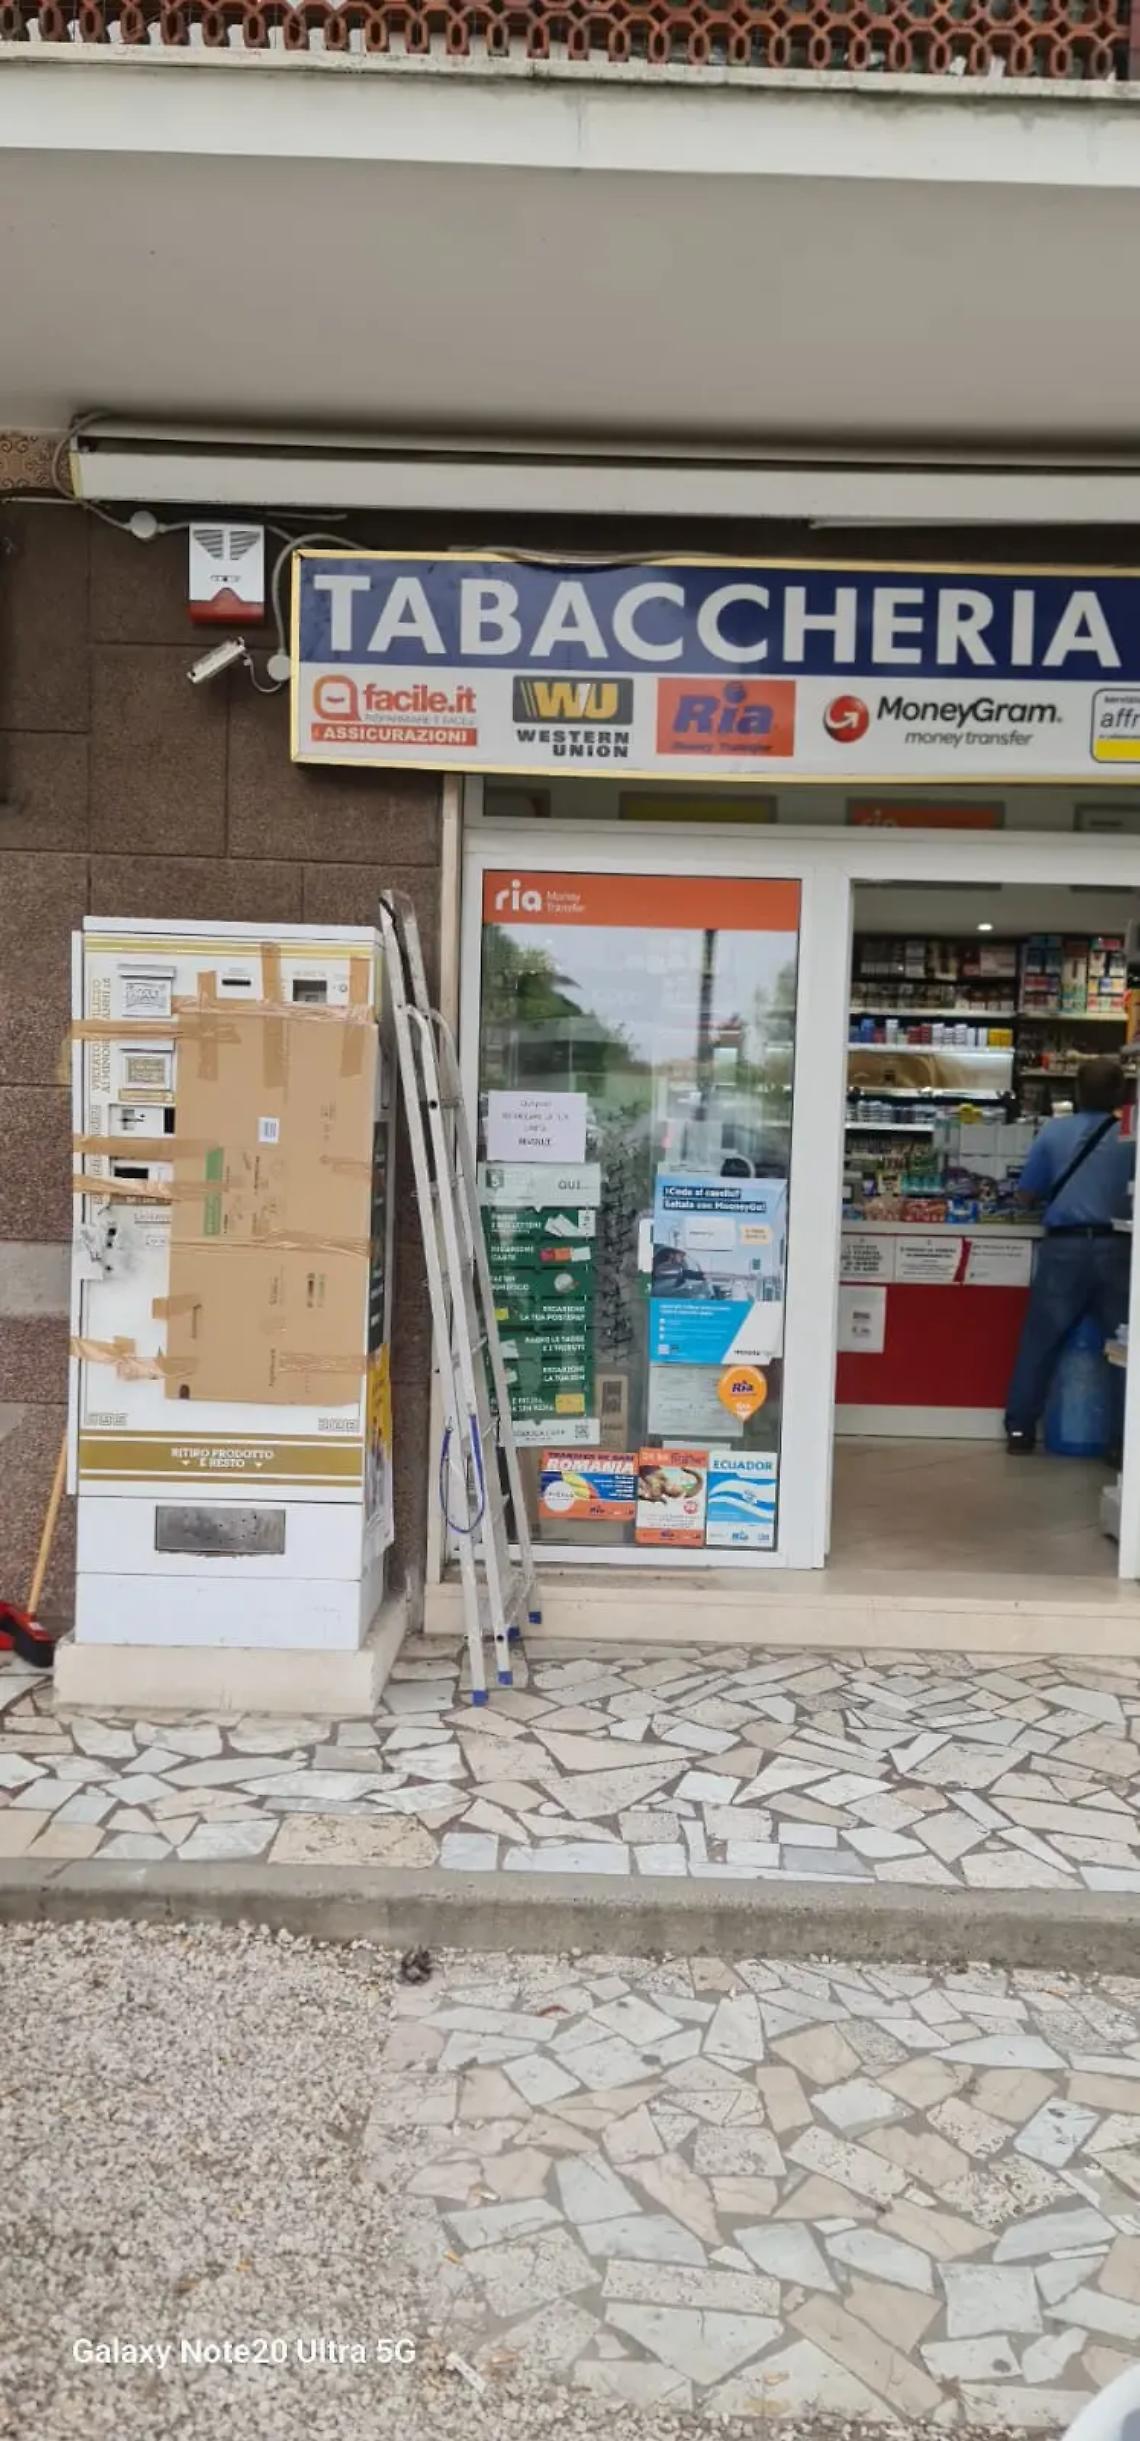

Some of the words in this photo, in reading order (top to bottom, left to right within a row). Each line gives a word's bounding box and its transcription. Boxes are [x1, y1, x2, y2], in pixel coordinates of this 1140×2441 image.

[313, 573, 1122, 668] TABACCHERIA
[363, 683, 477, 713] facile.it
[673, 680, 775, 735] Ria
[323, 727, 467, 743] ASSICURAZIONI
[517, 729, 630, 744] WESTERN
[905, 732, 962, 748] money
[966, 731, 1034, 747] transfer
[553, 744, 629, 758] UNION
[495, 879, 542, 911] ria
[546, 890, 581, 903] Money
[547, 903, 585, 912] Transfer
[212, 1448, 274, 1459] PRODOTTO
[713, 1460, 773, 1470] ECUADOR
